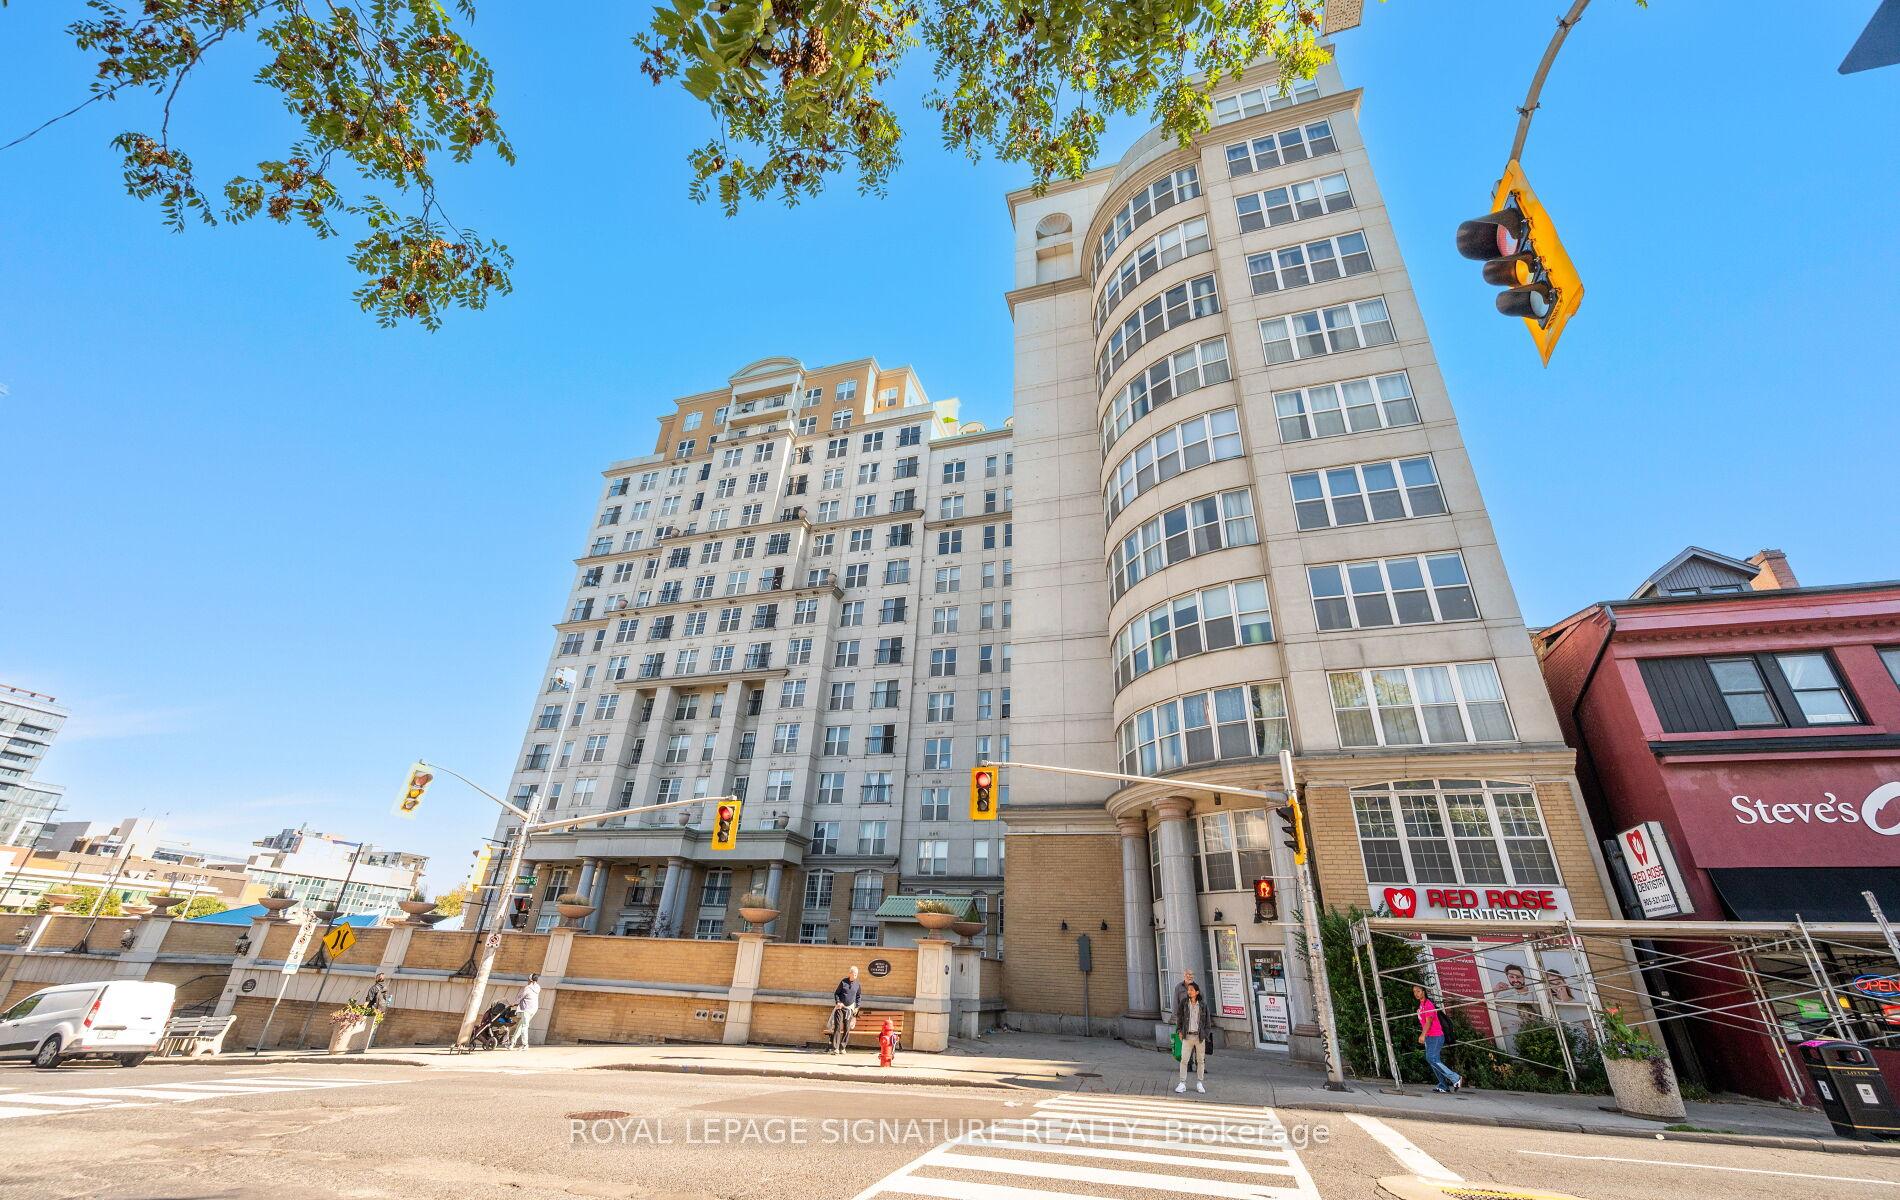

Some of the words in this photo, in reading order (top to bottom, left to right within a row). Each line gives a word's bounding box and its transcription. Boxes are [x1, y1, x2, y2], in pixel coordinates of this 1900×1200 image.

[1731, 792, 1860, 824] Steve's
[1631, 870, 1646, 884] RED
[1646, 865, 1665, 879] ROSE
[1637, 878, 1666, 892] DENTISTRY
[1426, 888, 1479, 909] RED
[1485, 889, 1558, 911] ROSE
[1448, 908, 1541, 920] DENTISTRY
[1855, 978, 1900, 992] OPEN
